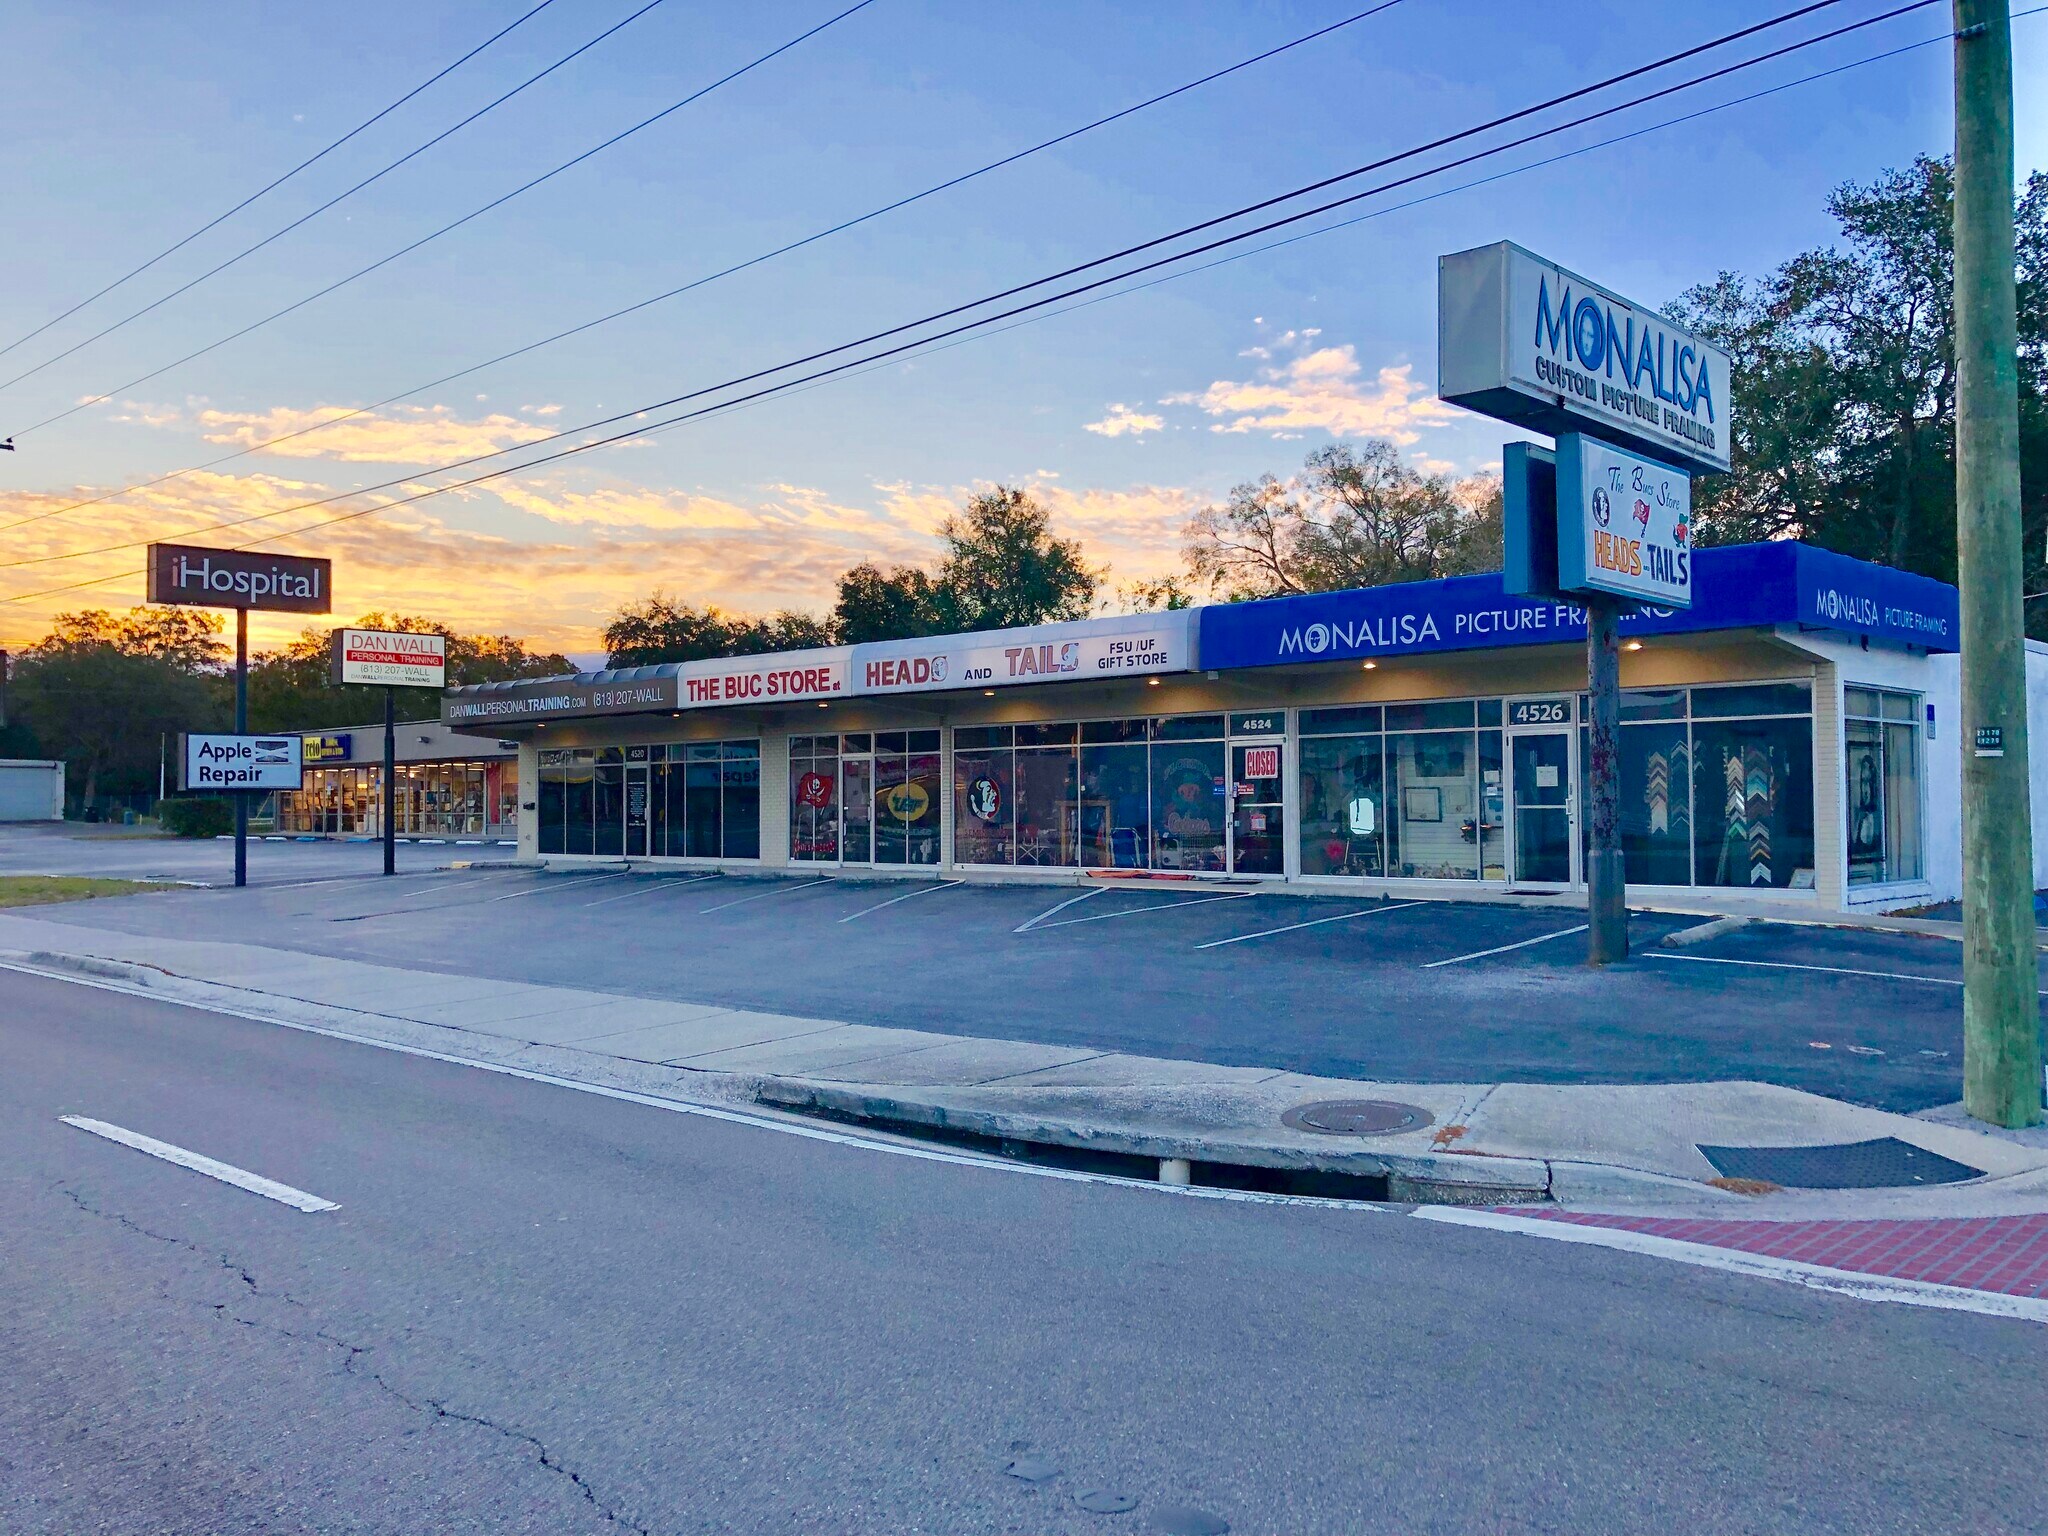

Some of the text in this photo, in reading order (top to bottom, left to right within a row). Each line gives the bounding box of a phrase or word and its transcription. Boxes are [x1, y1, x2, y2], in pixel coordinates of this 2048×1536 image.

[1535, 273, 1715, 424] MONALISA
[1535, 356, 1716, 450] CUSTOM PICTURE FRAMING
[1608, 465, 1680, 510] The Bucs Store
[1595, 529, 1642, 577] HEADS
[1647, 543, 1688, 586] TAILS
[172, 555, 320, 604] iHospital
[1816, 588, 1948, 636] MONALISA PICTURE FRAMING
[1278, 612, 1441, 655] MONALISA
[1454, 605, 1547, 635] PICTURE
[351, 634, 439, 654] DAN WALL
[1109, 641, 1133, 654] FSU
[351, 652, 439, 665] PERSONAL TRAINING
[1098, 652, 1168, 669] GIFT STORE
[360, 664, 430, 677] (813) 207-WALL
[964, 668, 992, 681] AND
[687, 678, 720, 702] THE
[725, 674, 762, 698] BUC
[767, 668, 831, 696] STORE
[592, 689, 615, 707] (813)
[616, 687, 663, 706] 207-WALL
[1517, 704, 1564, 722] 4526
[1243, 719, 1272, 730] 4524
[198, 741, 252, 763] Apple
[630, 749, 645, 758] 4520
[1246, 750, 1276, 776] CLOSED
[200, 766, 263, 785] Repair
